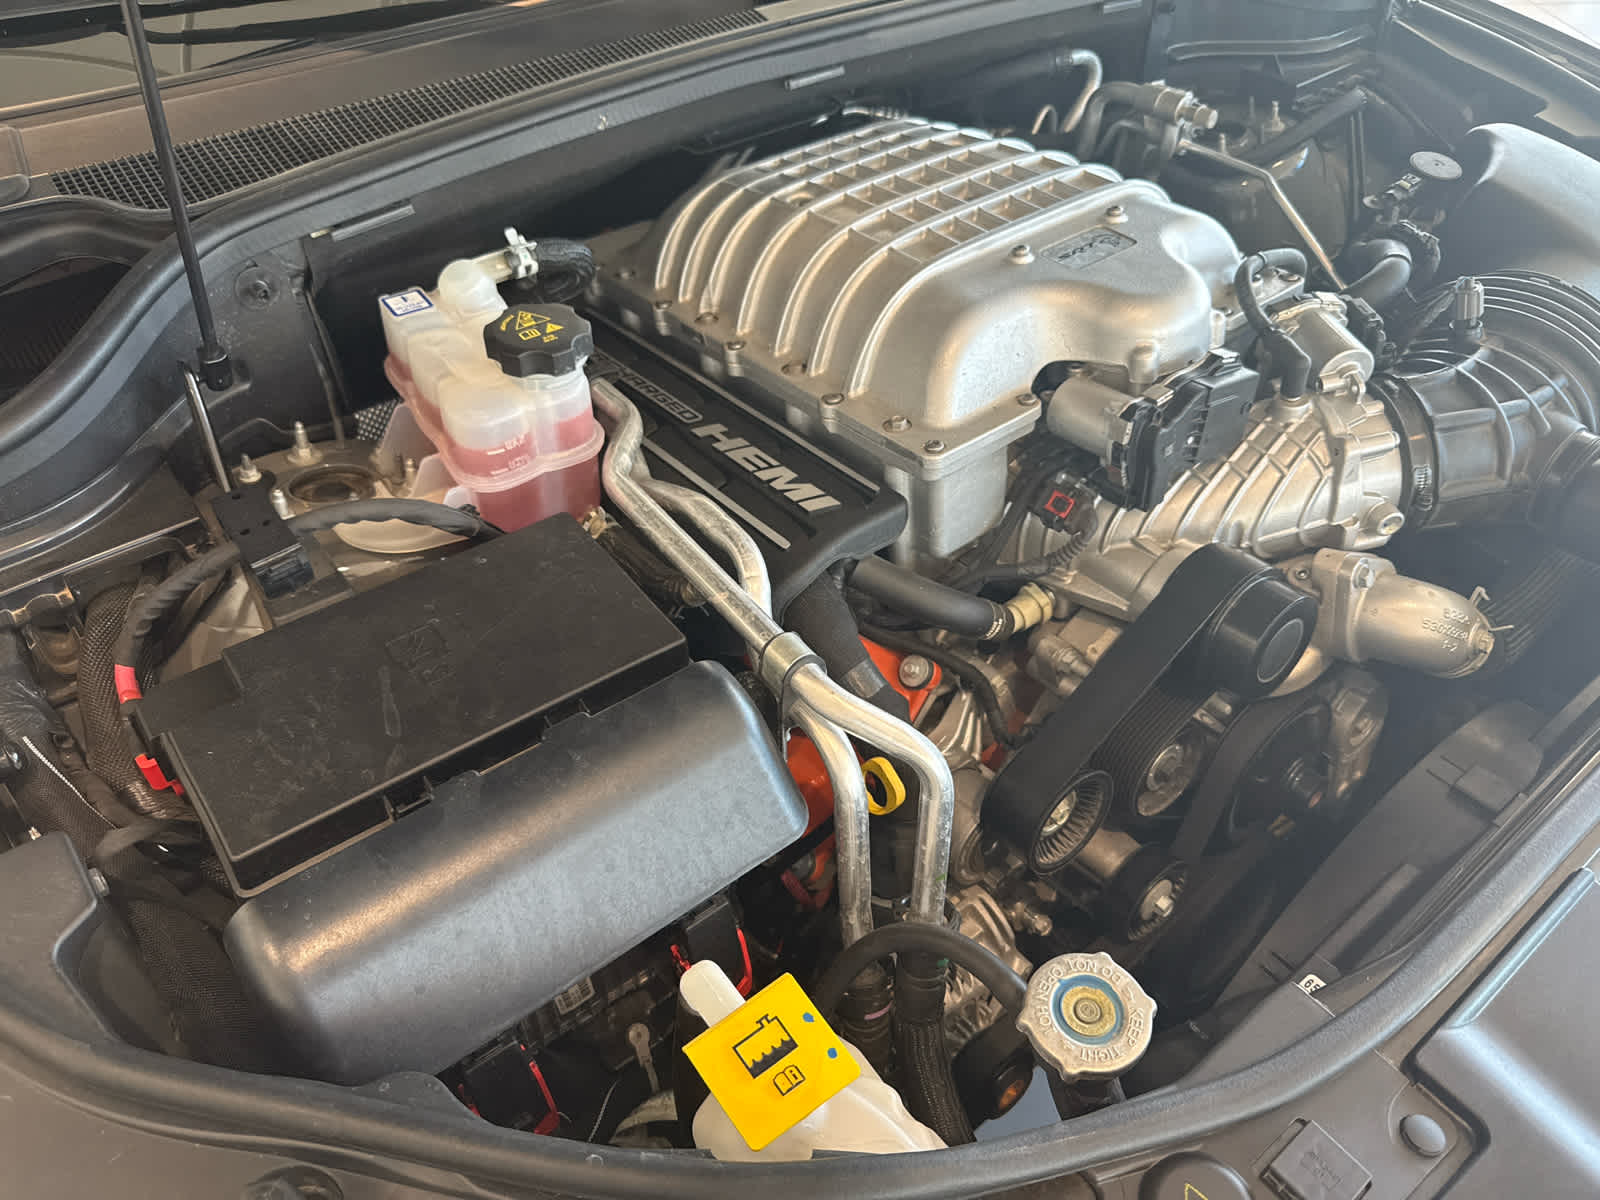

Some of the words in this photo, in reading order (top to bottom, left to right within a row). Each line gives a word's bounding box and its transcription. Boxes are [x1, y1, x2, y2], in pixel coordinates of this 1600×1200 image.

[691, 424, 841, 512] HEMI
[1066, 959, 1097, 972] NOT
[1102, 967, 1124, 985] DO
[1034, 966, 1064, 1000] OPEN
[1128, 1007, 1144, 1047] KEEP
[1080, 1046, 1123, 1062] TIGHT
